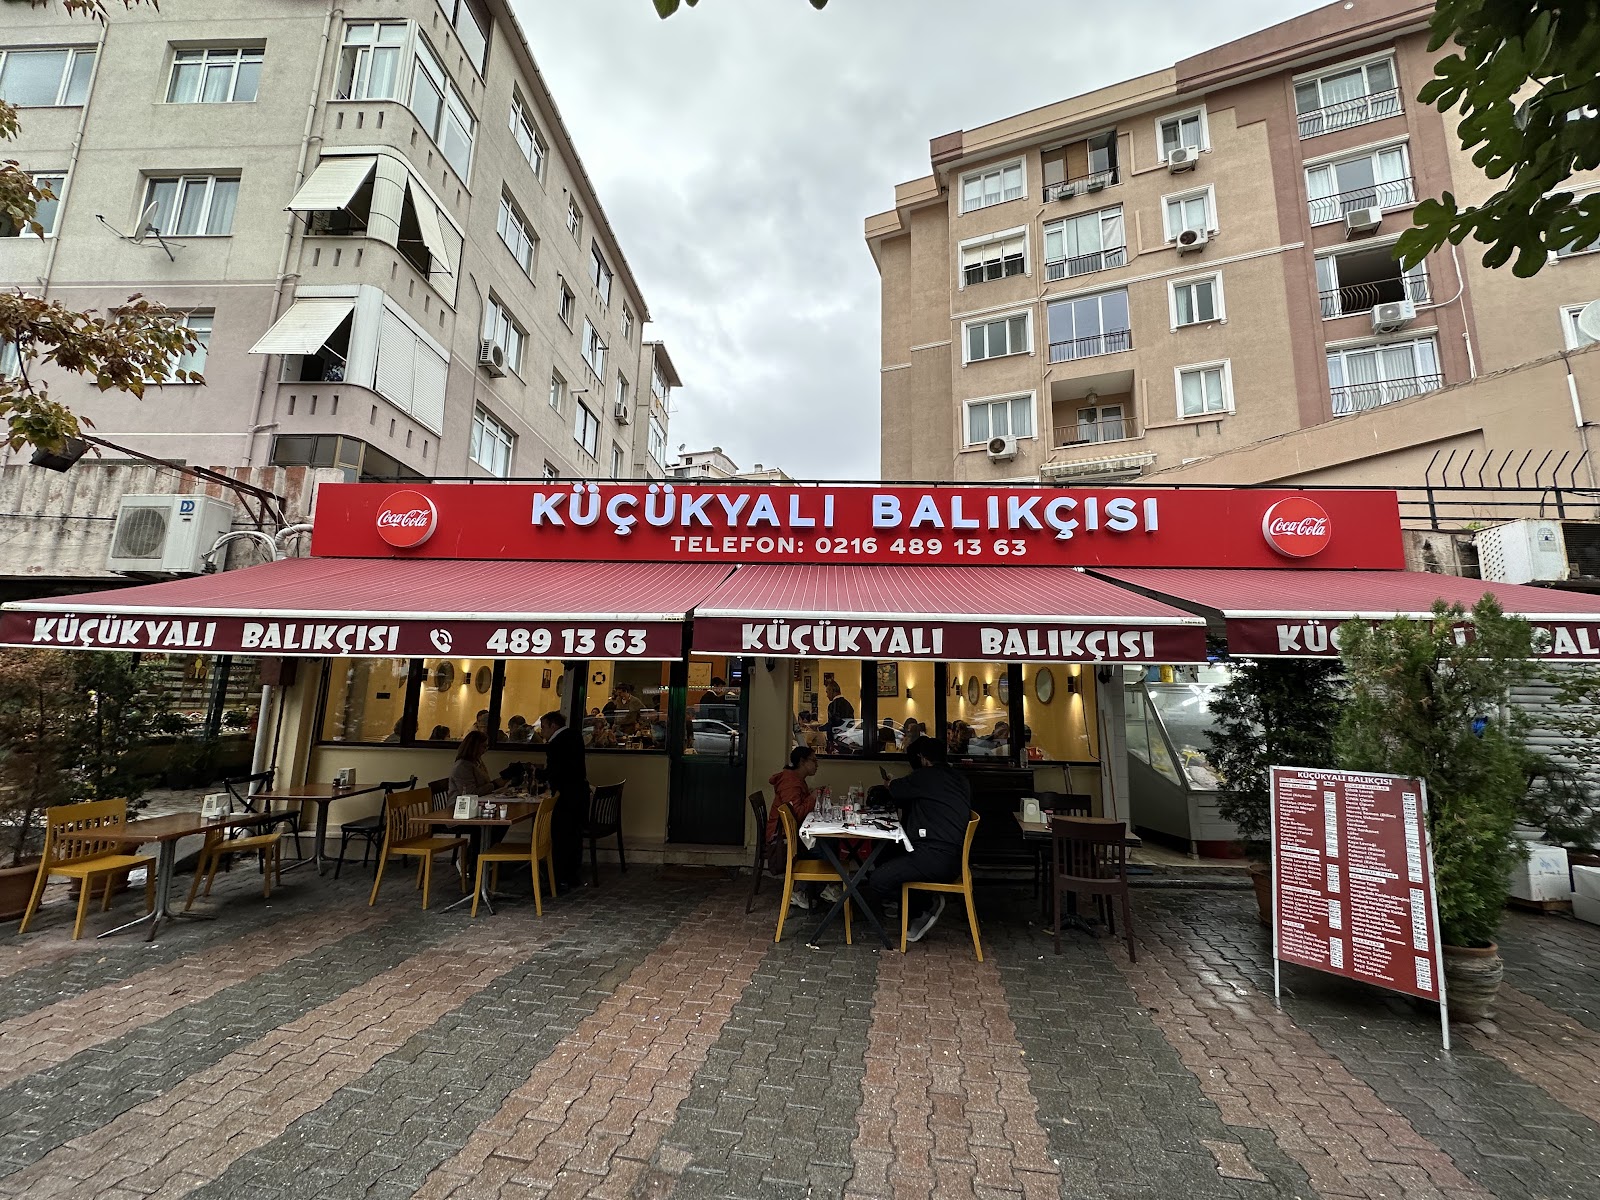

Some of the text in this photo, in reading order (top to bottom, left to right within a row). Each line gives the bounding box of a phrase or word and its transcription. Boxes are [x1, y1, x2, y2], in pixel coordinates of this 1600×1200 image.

[377, 509, 431, 527] Coca-Cola
[531, 484, 1159, 541] KÜÇÜKYALI BALIKÇISI
[1269, 517, 1327, 536] Coca-Cola
[671, 536, 1027, 556] TELEFON: 0216 489 13 63
[32, 613, 647, 655] KÜÇÜKYALI BALIKÇISI 489 13 63
[742, 619, 1155, 662] KÜÇÜKYALI BALIKÇISI
[1530, 626, 1600, 654] BAL
